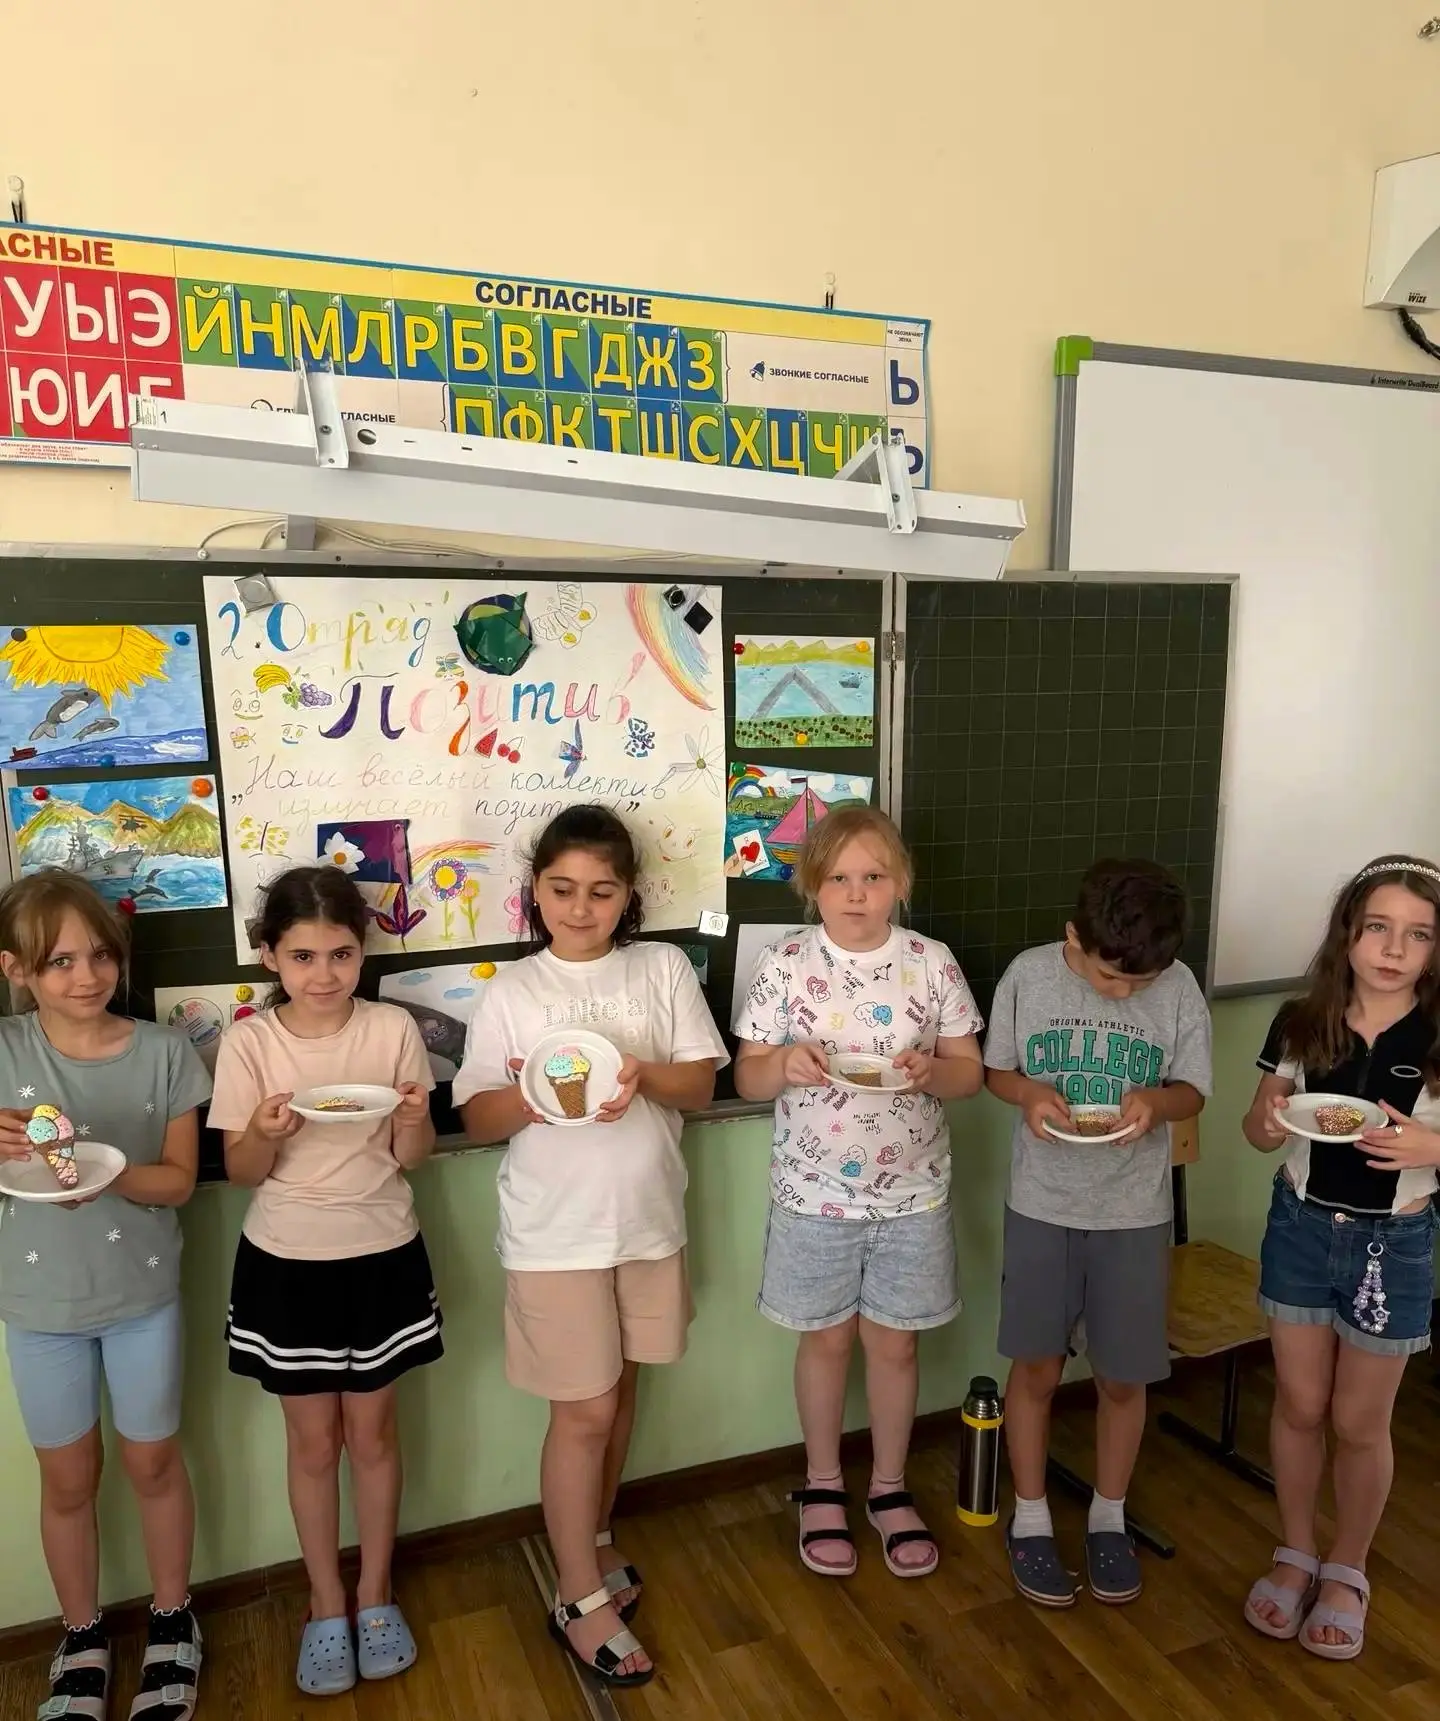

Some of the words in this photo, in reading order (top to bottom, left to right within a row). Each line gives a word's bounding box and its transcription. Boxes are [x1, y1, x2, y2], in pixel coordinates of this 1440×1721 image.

[476, 281, 652, 319] СОГЛАСНЫЕ
[769, 368, 812, 379] ЗВОНКИЕ
[814, 372, 869, 384] СОГЛАСНЫЕ
[341, 411, 396, 423] ГЛАСНЫЕ
[266, 602, 431, 669] Отряд
[318, 652, 646, 756] Позитив
[511, 766, 667, 800] коллектив
[1050, 1017, 1093, 1027] ORIGINAL
[1098, 1020, 1145, 1036] ATHLETIC
[1027, 1029, 1164, 1087] COLLEGE
[1056, 1074, 1122, 1105] 1991
[778, 1177, 806, 1207] LOVE
